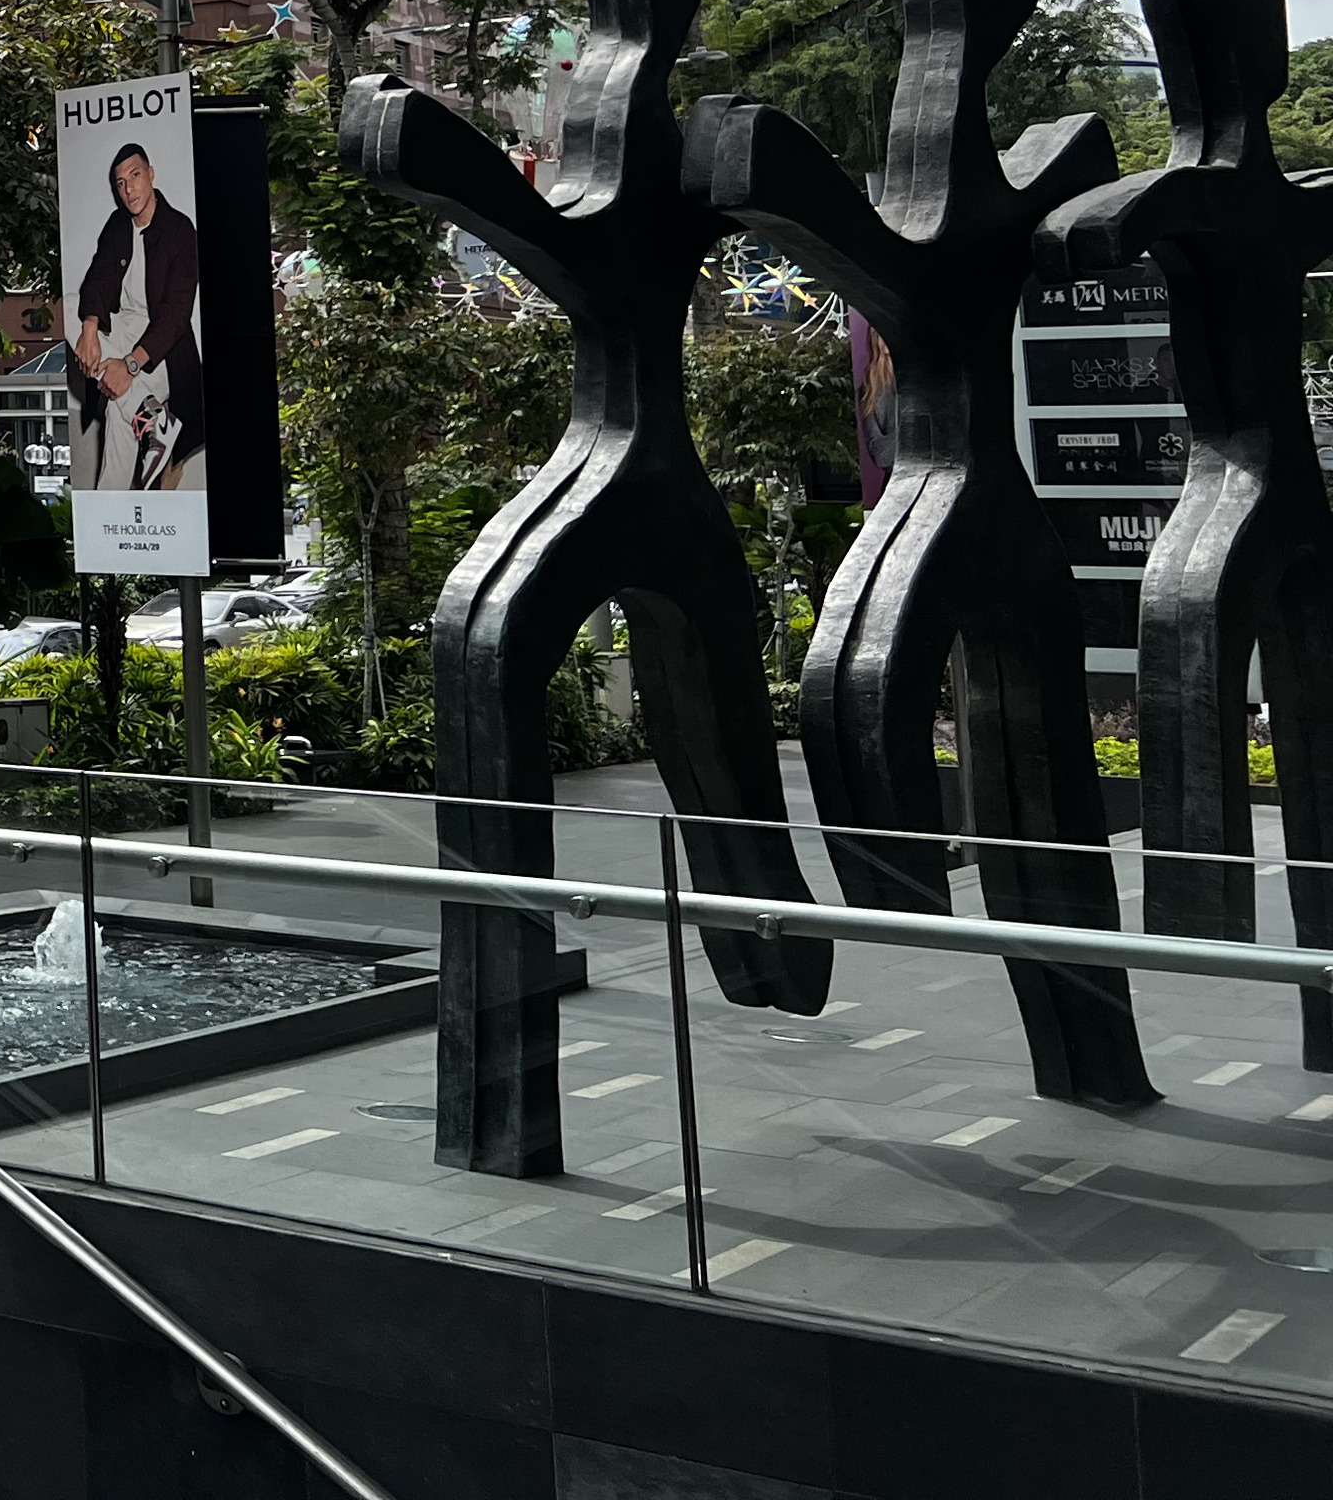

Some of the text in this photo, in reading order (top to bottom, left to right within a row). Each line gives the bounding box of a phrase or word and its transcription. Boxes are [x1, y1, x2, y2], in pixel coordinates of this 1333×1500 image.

[64, 86, 181, 127] HUBLOT
[1071, 358, 1143, 374] MARKS
[1072, 373, 1160, 390] SPENCER
[103, 524, 177, 536] THE HOUR GLASS
[1099, 516, 1162, 539] MUJI
